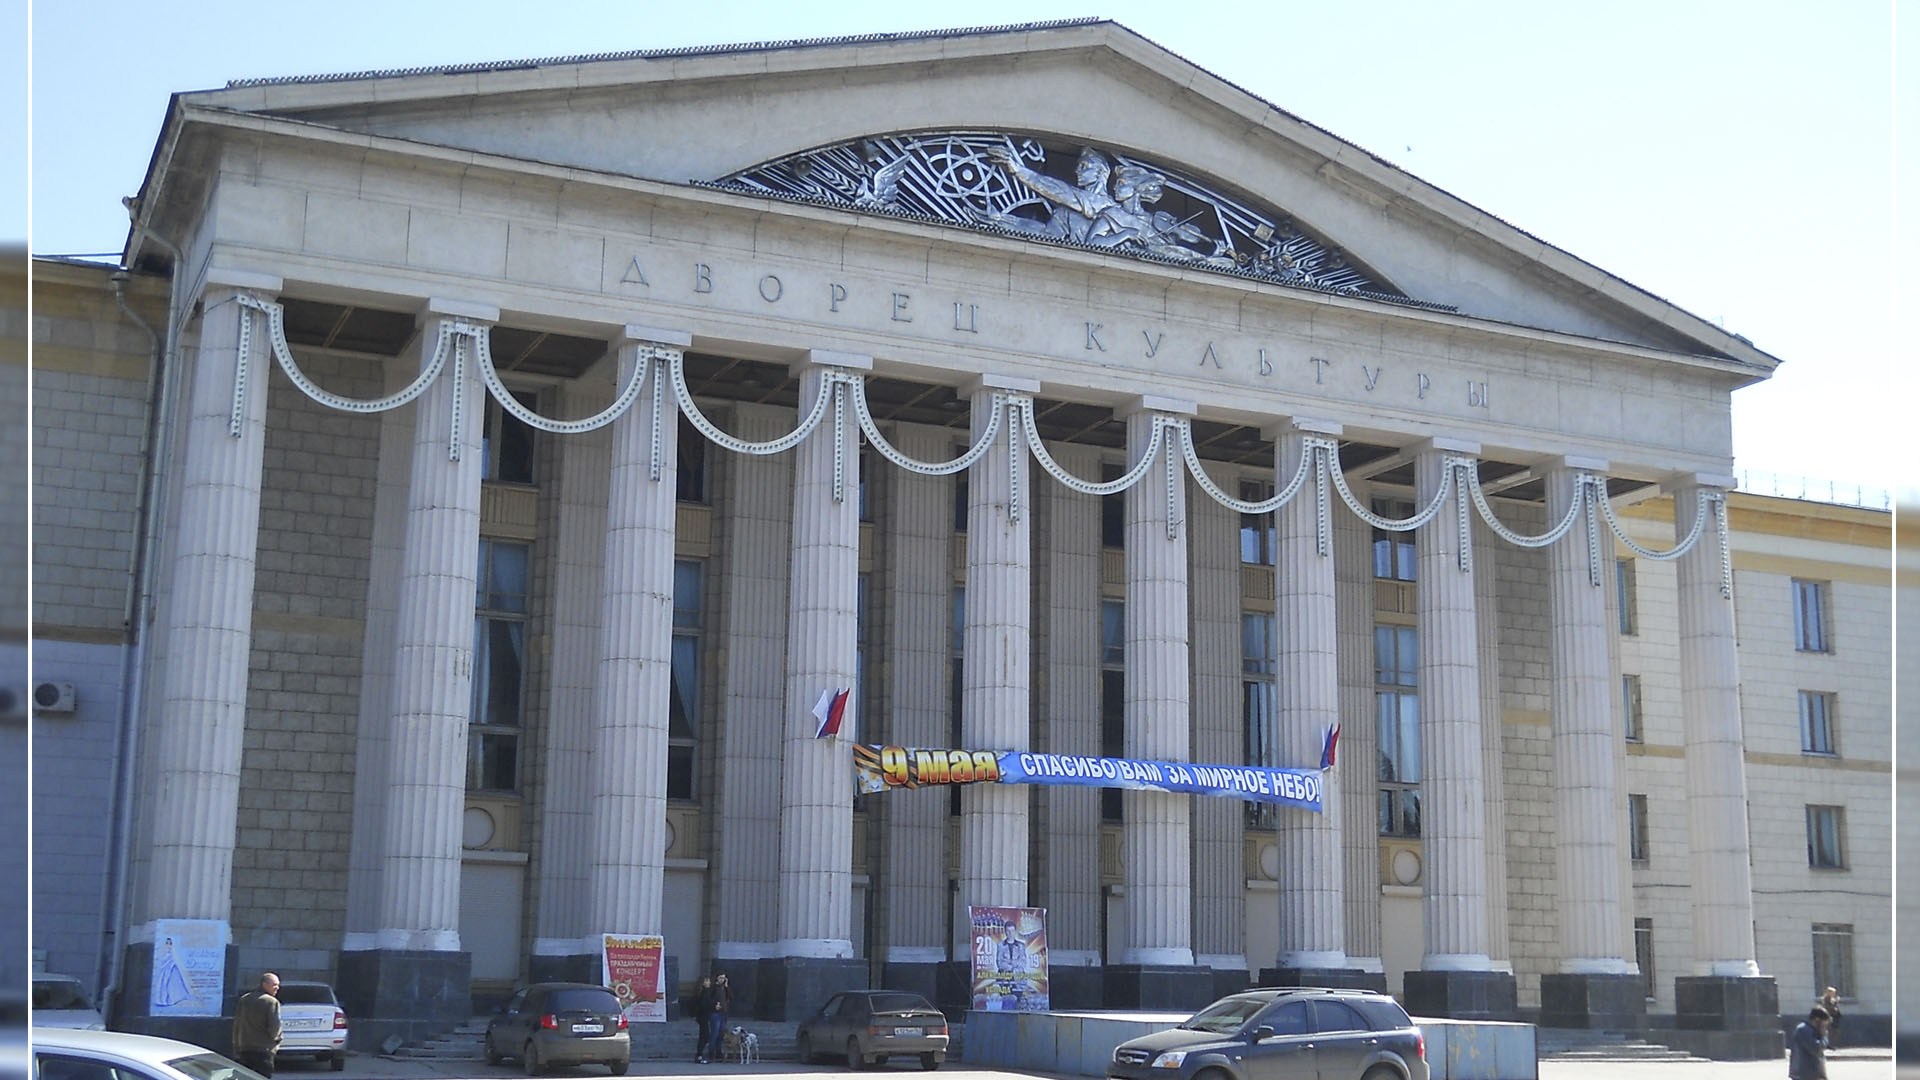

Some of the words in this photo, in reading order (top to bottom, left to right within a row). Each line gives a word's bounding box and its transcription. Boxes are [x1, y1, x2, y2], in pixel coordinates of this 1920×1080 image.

[620, 255, 979, 334] ДВОРЕЦ
[1084, 322, 1489, 409] КУЛЬТУРЫ
[881, 745, 909, 785] 9
[1020, 753, 1116, 779] СПАСИБО
[1117, 760, 1163, 782] ВАМ
[1164, 765, 1193, 785] ЗА
[1192, 766, 1270, 795] МИРНОЕ
[1270, 772, 1320, 803] НЕБО!
[976, 936, 993, 955] 20
